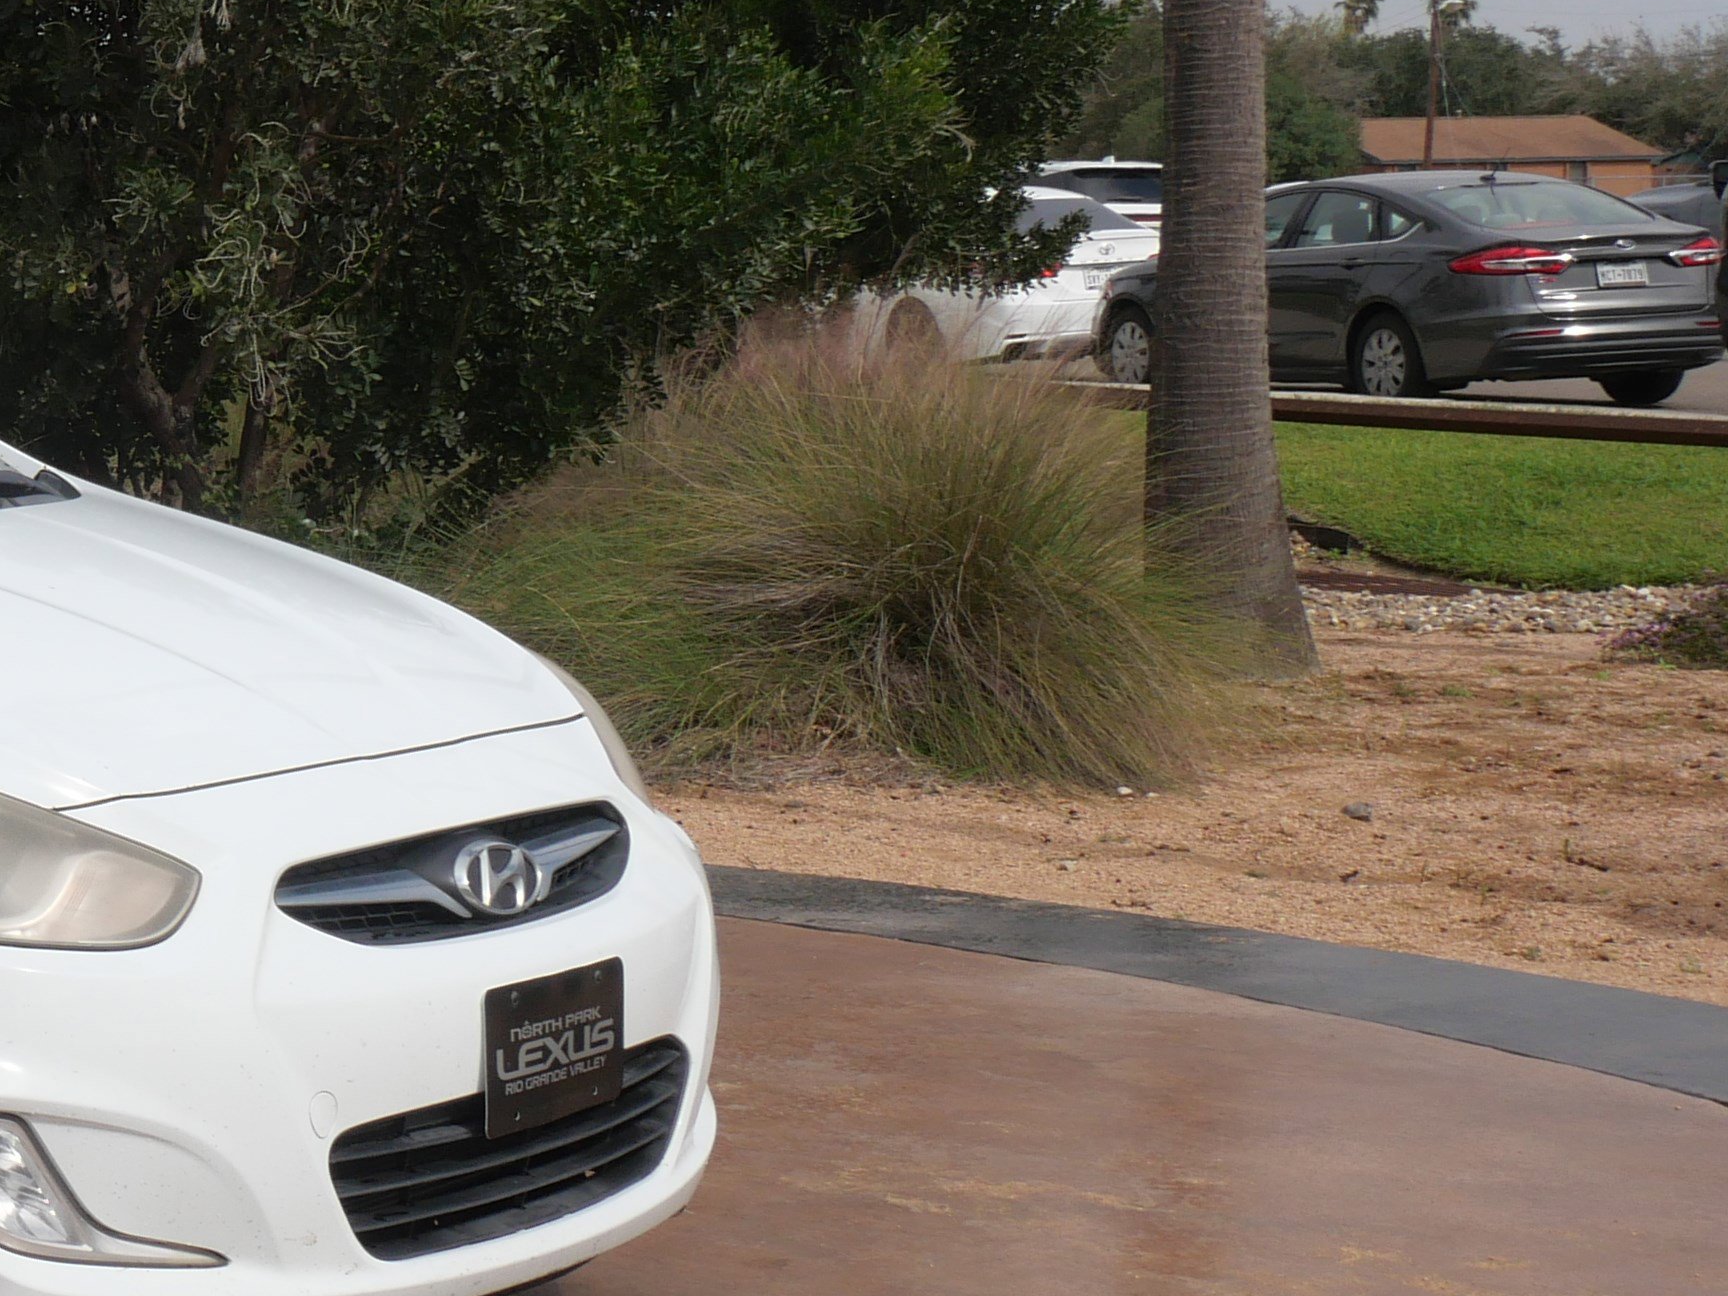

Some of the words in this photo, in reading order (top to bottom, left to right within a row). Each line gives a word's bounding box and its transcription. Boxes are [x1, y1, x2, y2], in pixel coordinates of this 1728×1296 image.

[510, 1017, 563, 1043] NORTH
[565, 1006, 602, 1028] PARK
[496, 1017, 615, 1081] LEXUS
[505, 1079, 524, 1096] RIO
[525, 1067, 568, 1090] GRANDE
[569, 1054, 608, 1076] VALLEY
